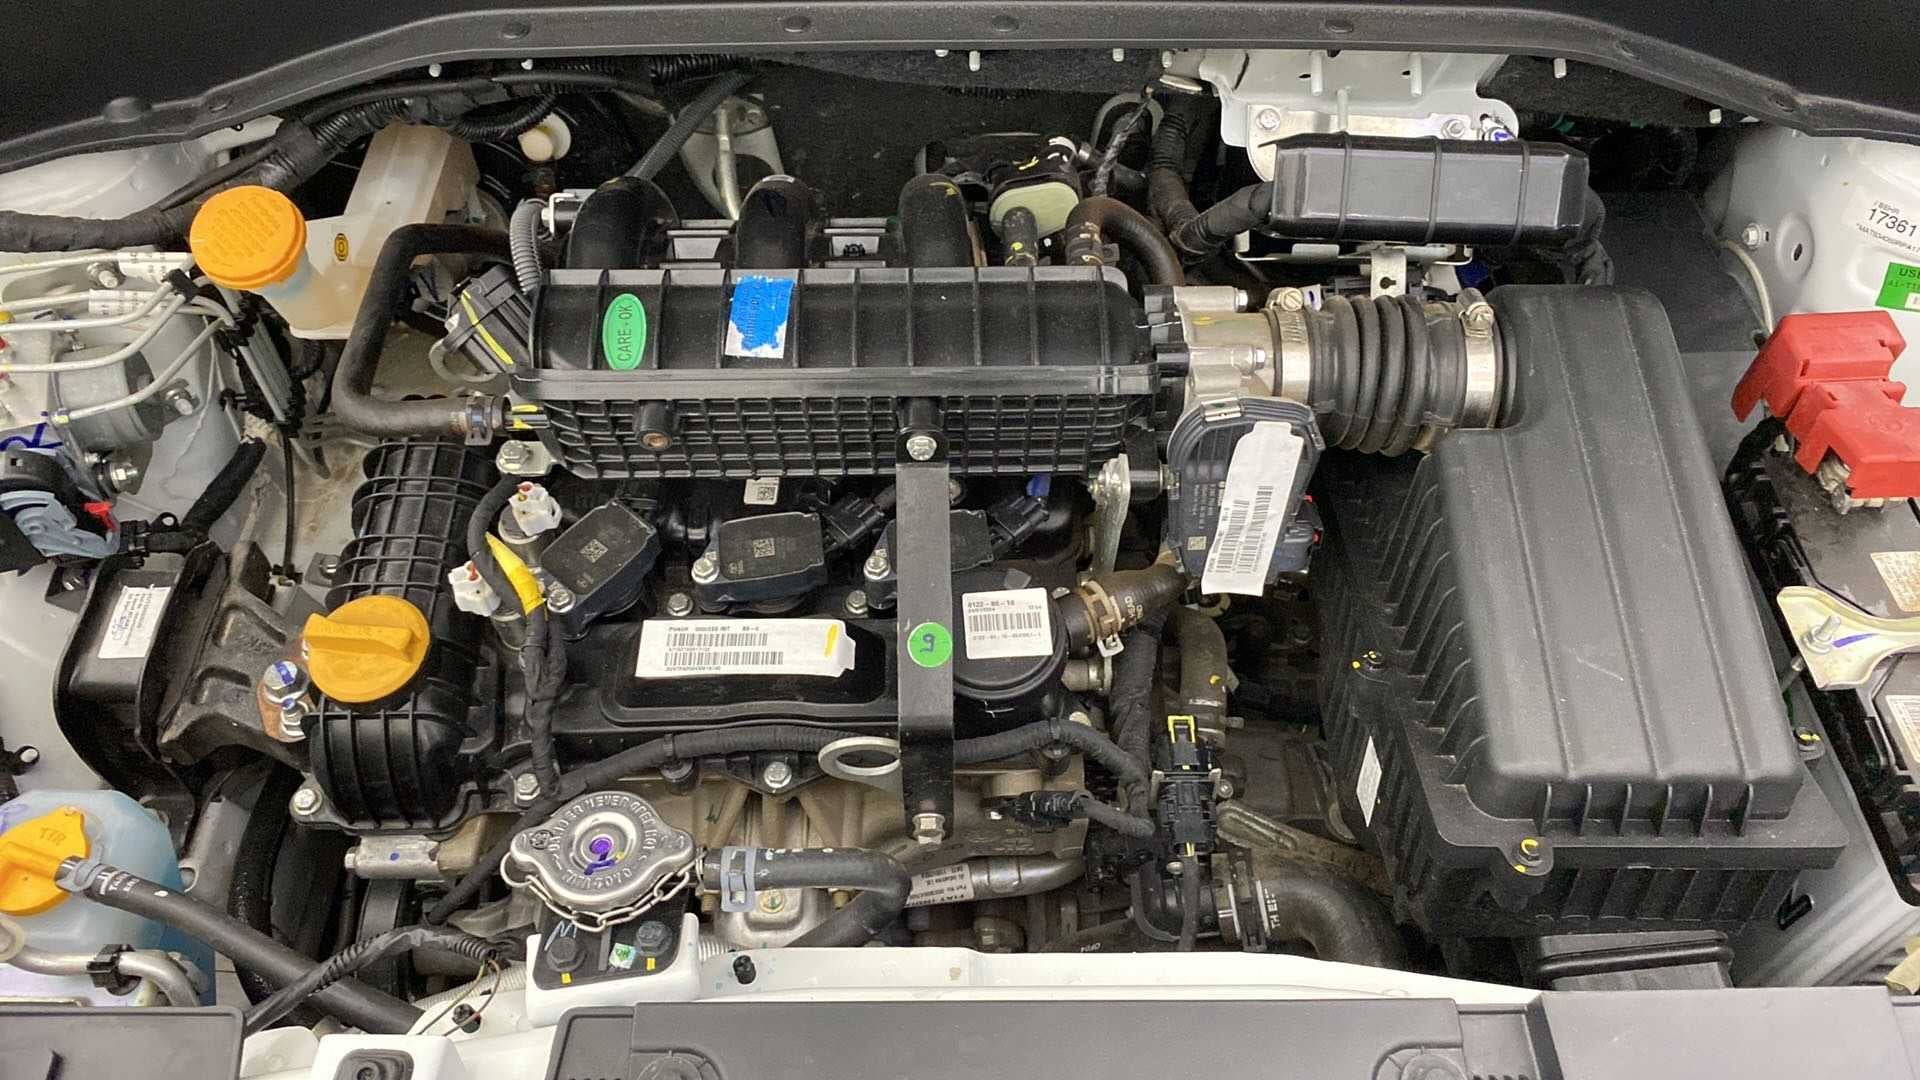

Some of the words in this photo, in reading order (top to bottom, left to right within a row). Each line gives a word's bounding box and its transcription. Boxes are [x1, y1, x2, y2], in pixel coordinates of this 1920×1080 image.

[1867, 208, 1918, 237] 17361
[618, 328, 633, 361] CARE
[585, 795, 630, 809] NEVER
[630, 800, 656, 826] OPEN
